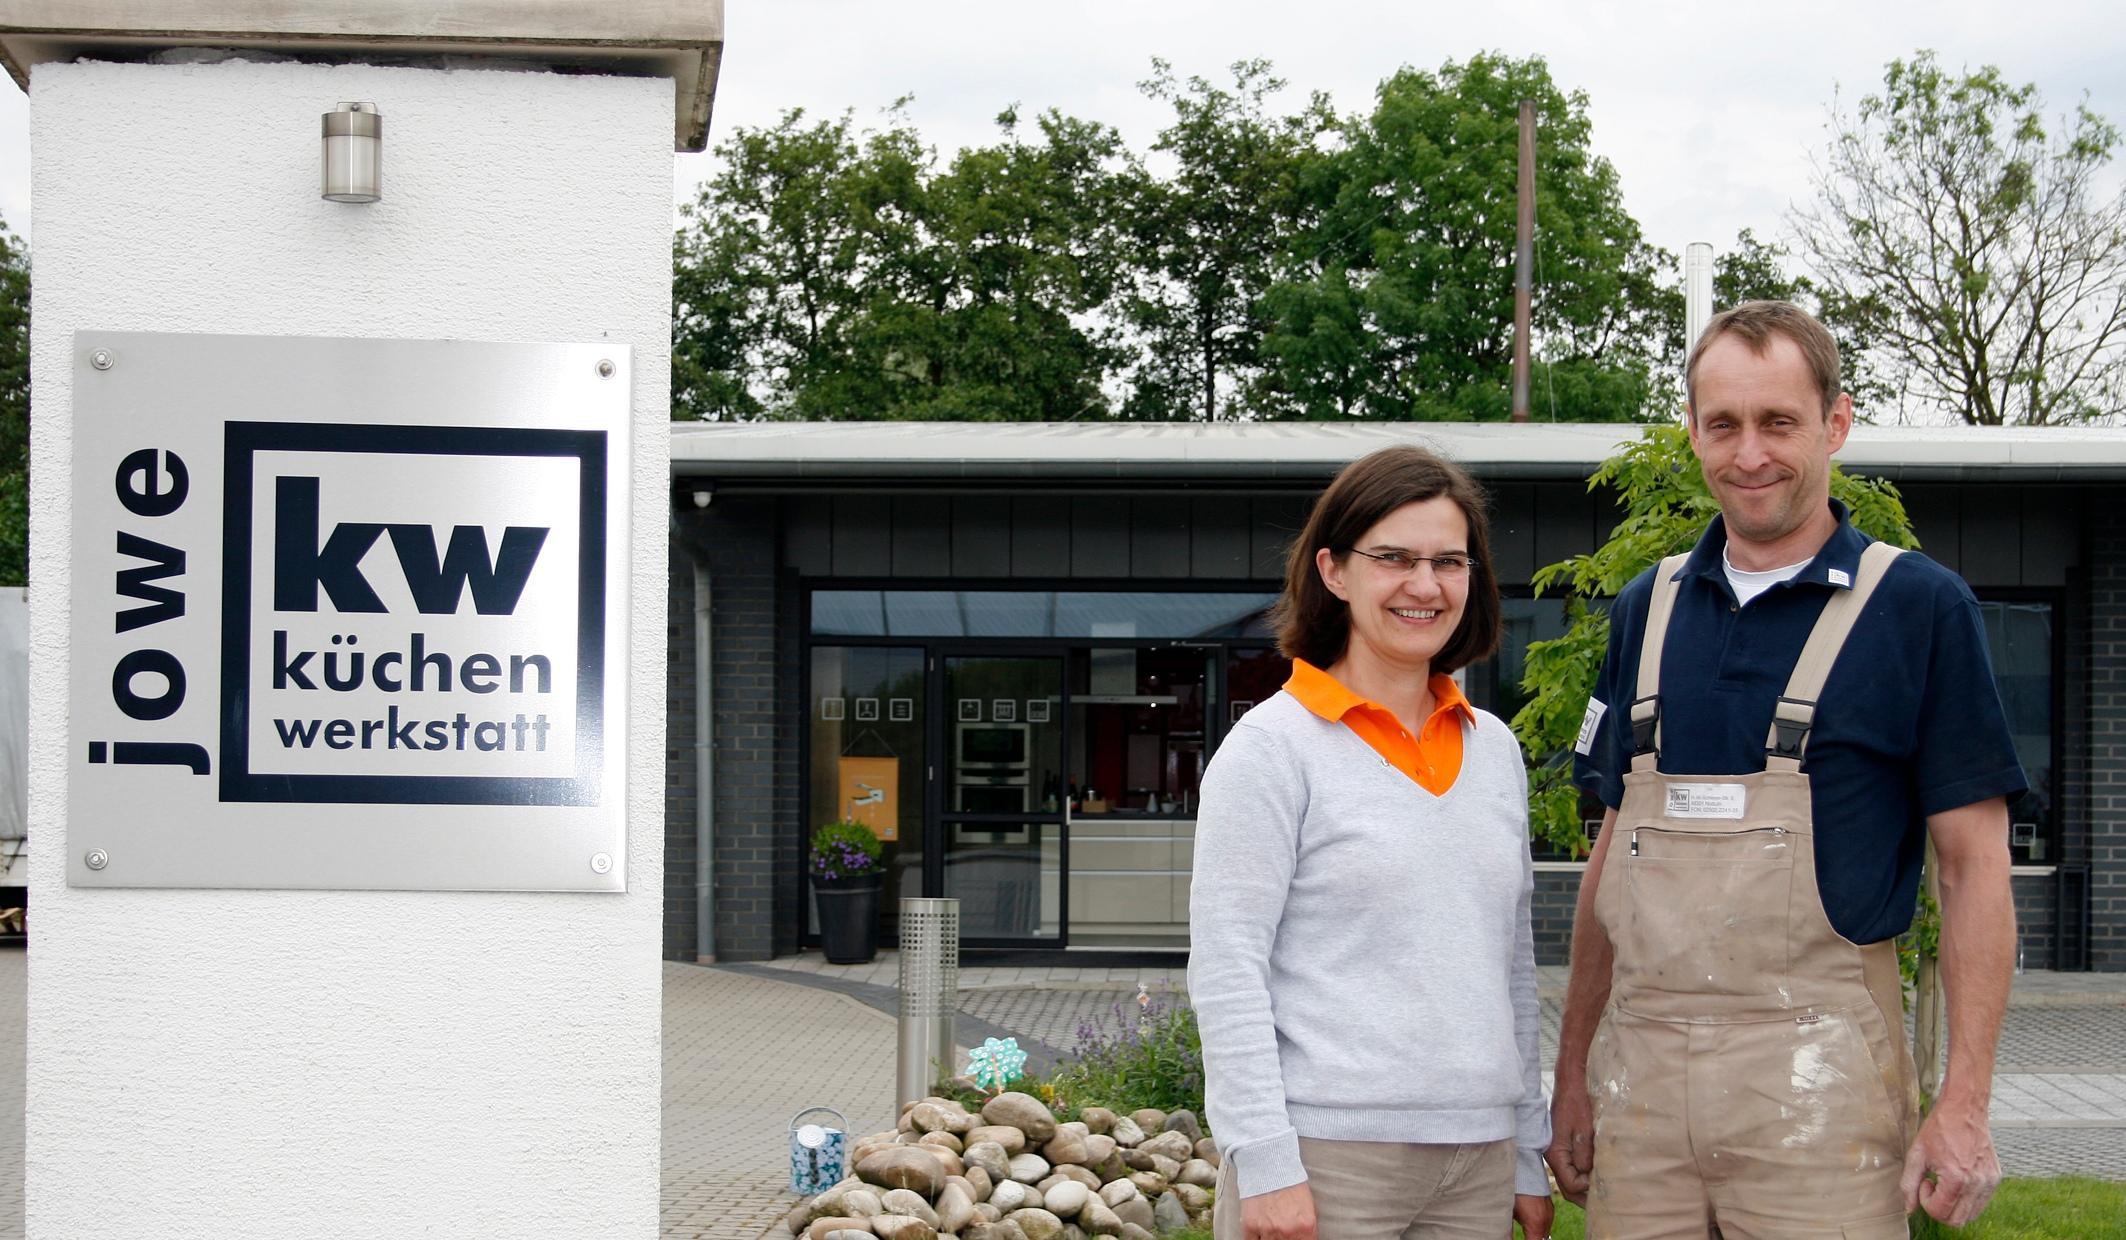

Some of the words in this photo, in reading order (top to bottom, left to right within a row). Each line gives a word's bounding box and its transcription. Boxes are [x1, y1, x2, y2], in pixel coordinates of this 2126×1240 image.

[274, 475, 550, 615] kw
[88, 448, 210, 776] jowe
[273, 630, 552, 694] küchen
[273, 705, 551, 752] werkstatt
